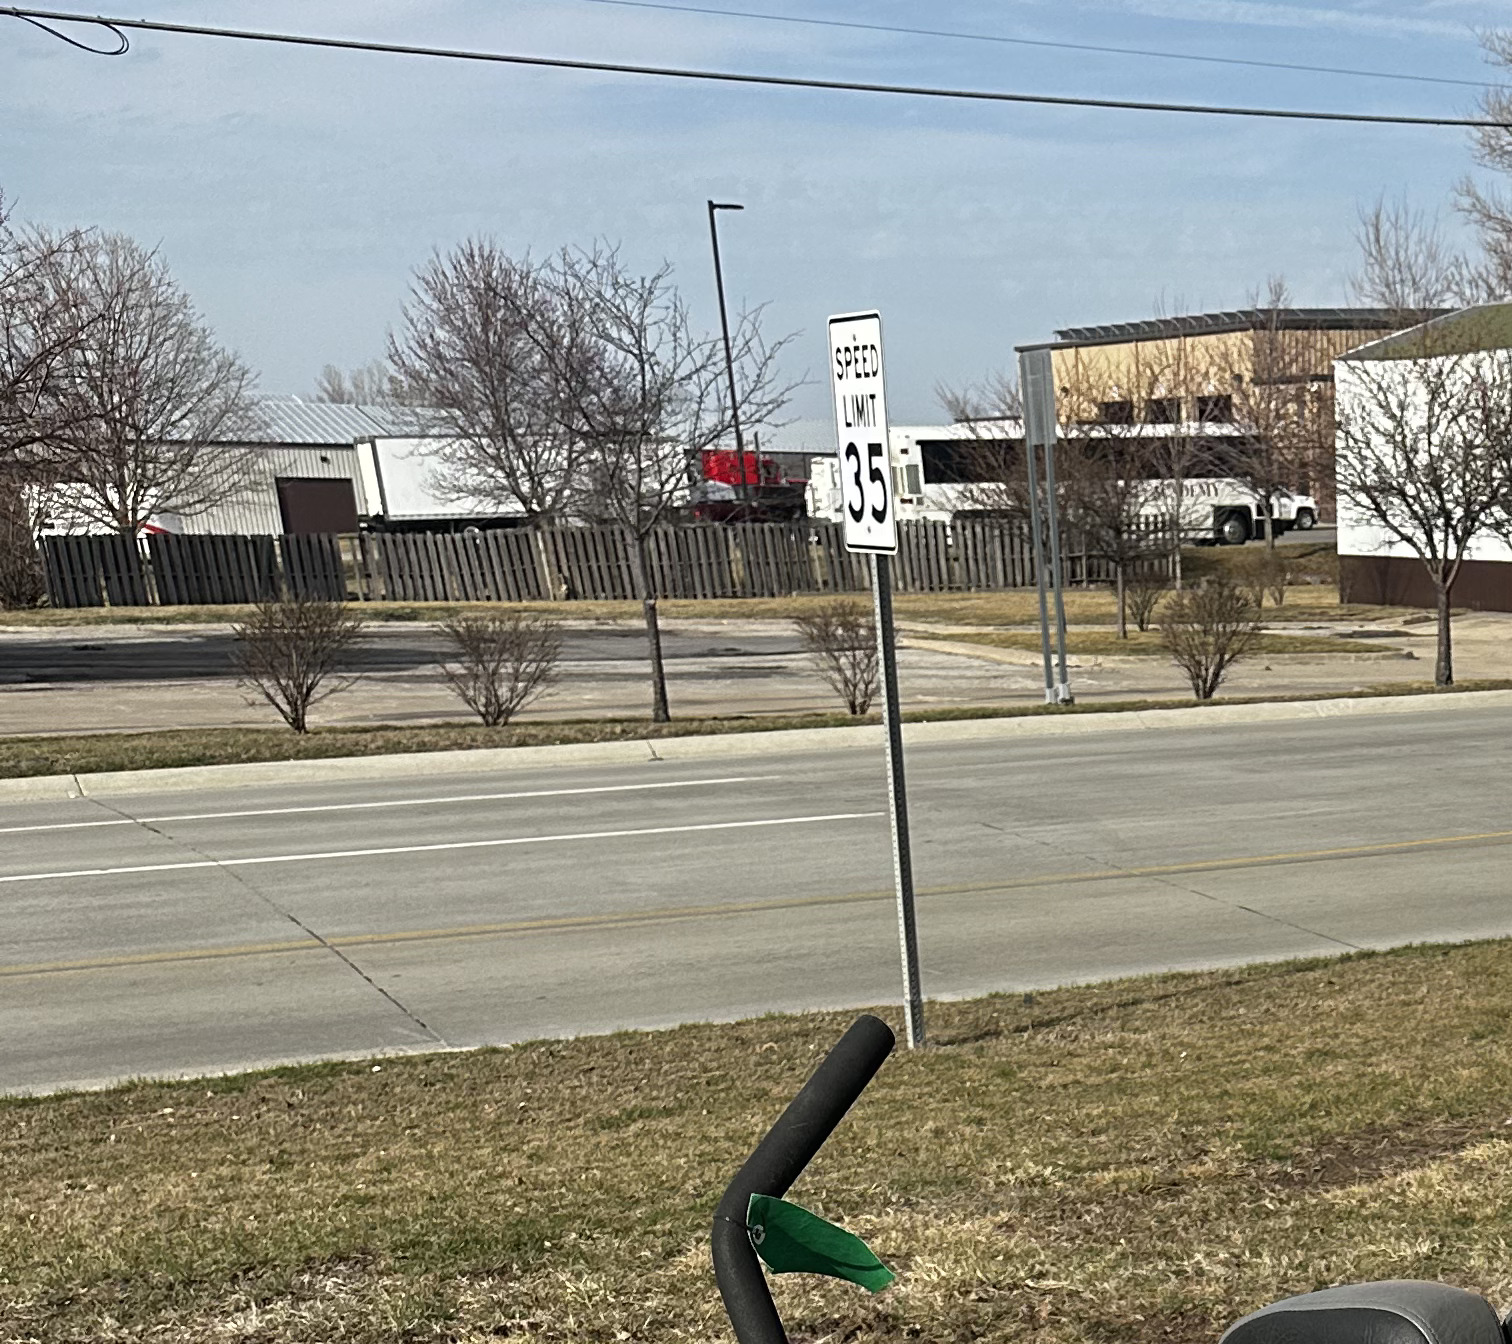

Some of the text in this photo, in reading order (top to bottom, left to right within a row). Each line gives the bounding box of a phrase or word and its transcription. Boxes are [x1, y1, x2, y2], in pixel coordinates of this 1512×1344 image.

[835, 344, 879, 380] SPEED
[843, 393, 877, 428] LIMIT
[845, 441, 888, 524] 35
